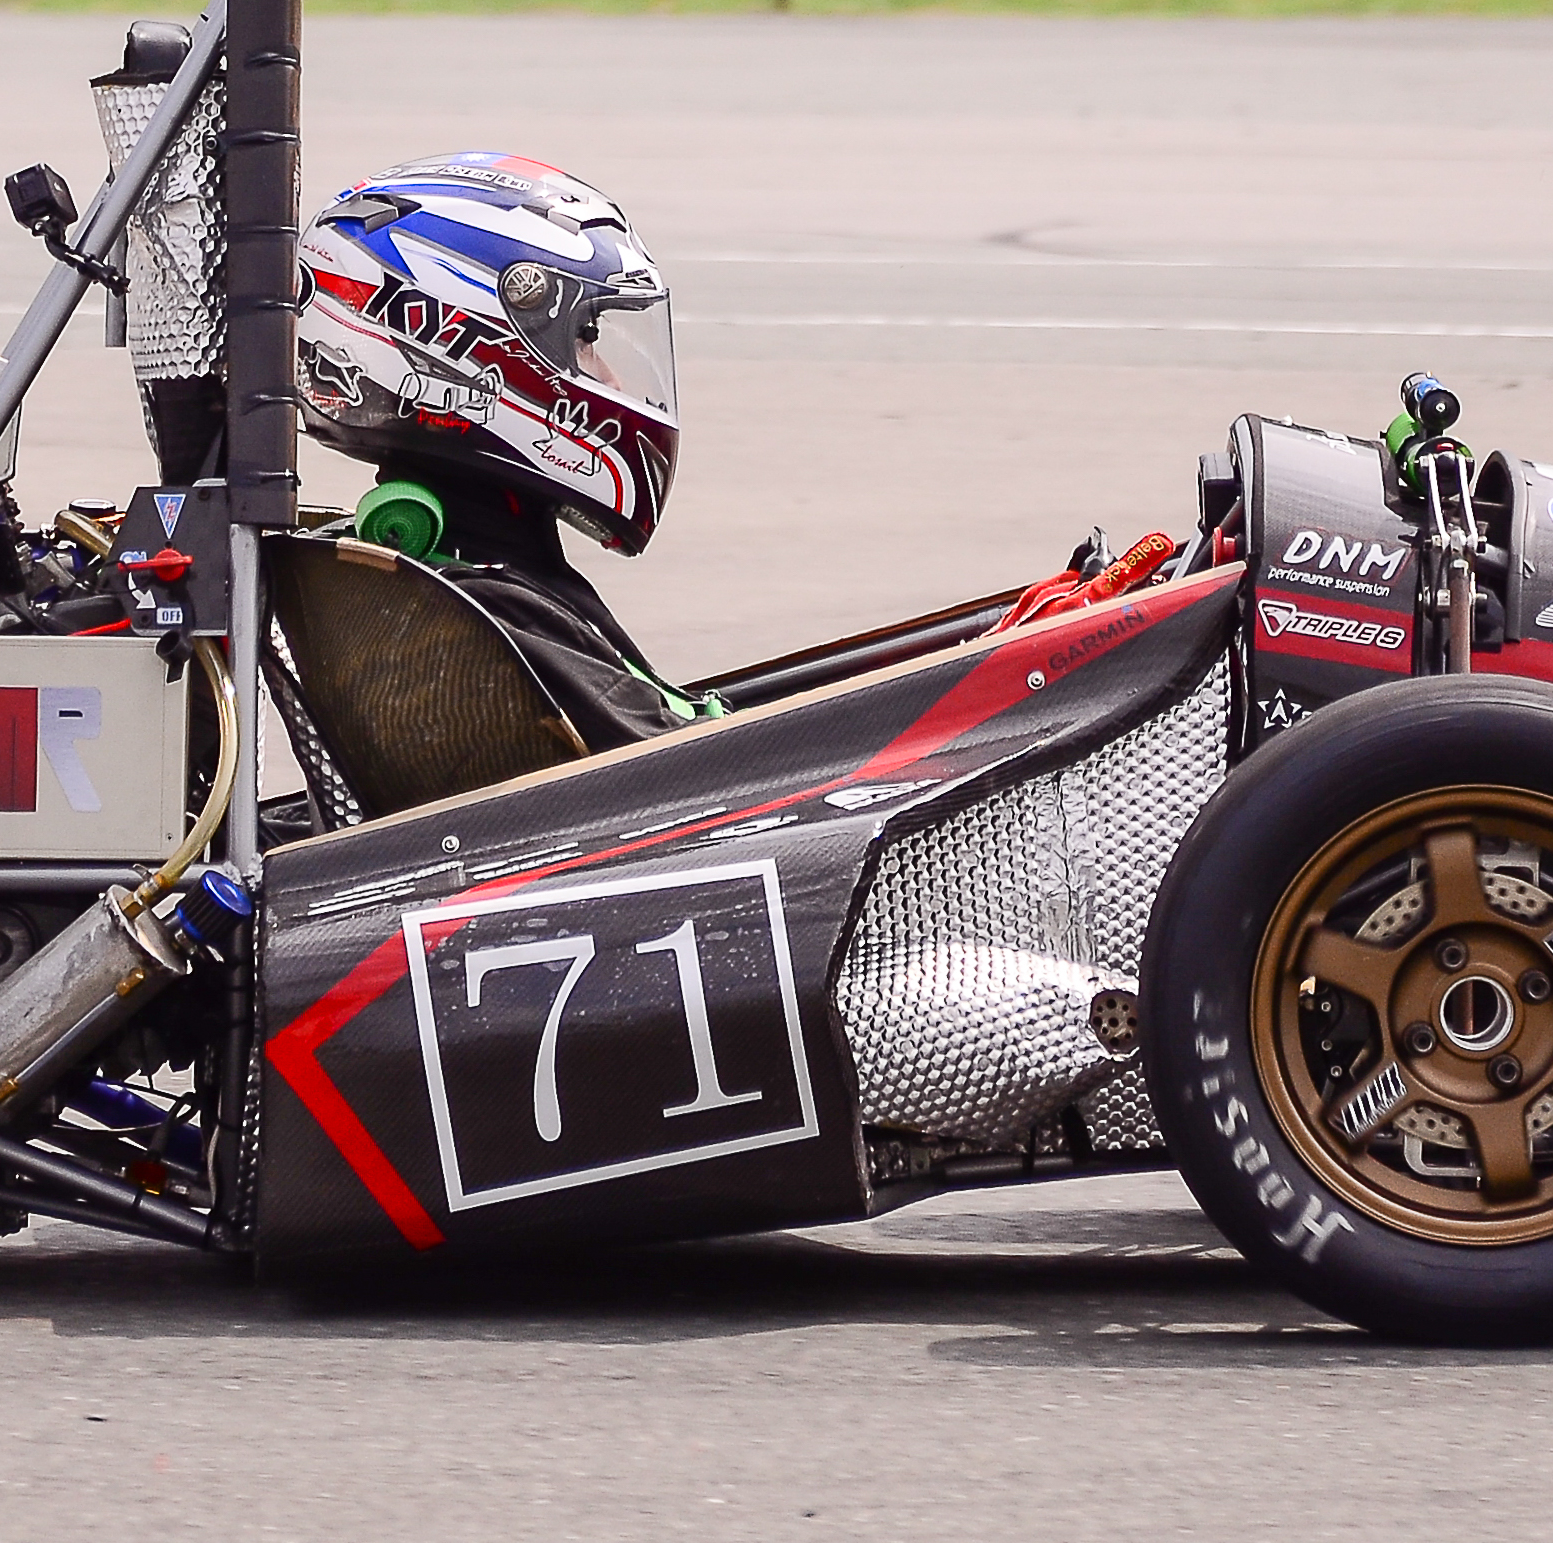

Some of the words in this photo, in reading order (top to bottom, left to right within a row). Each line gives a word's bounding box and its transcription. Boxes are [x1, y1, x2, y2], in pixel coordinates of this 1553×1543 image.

[1282, 530, 1407, 580] DNM
[1267, 567, 1334, 589] performance
[1334, 577, 1391, 597] suspension
[1049, 609, 1146, 671] GARMIN
[1285, 611, 1382, 645] TRIPLE
[1376, 626, 1406, 649] S
[464, 919, 763, 1142] 71
